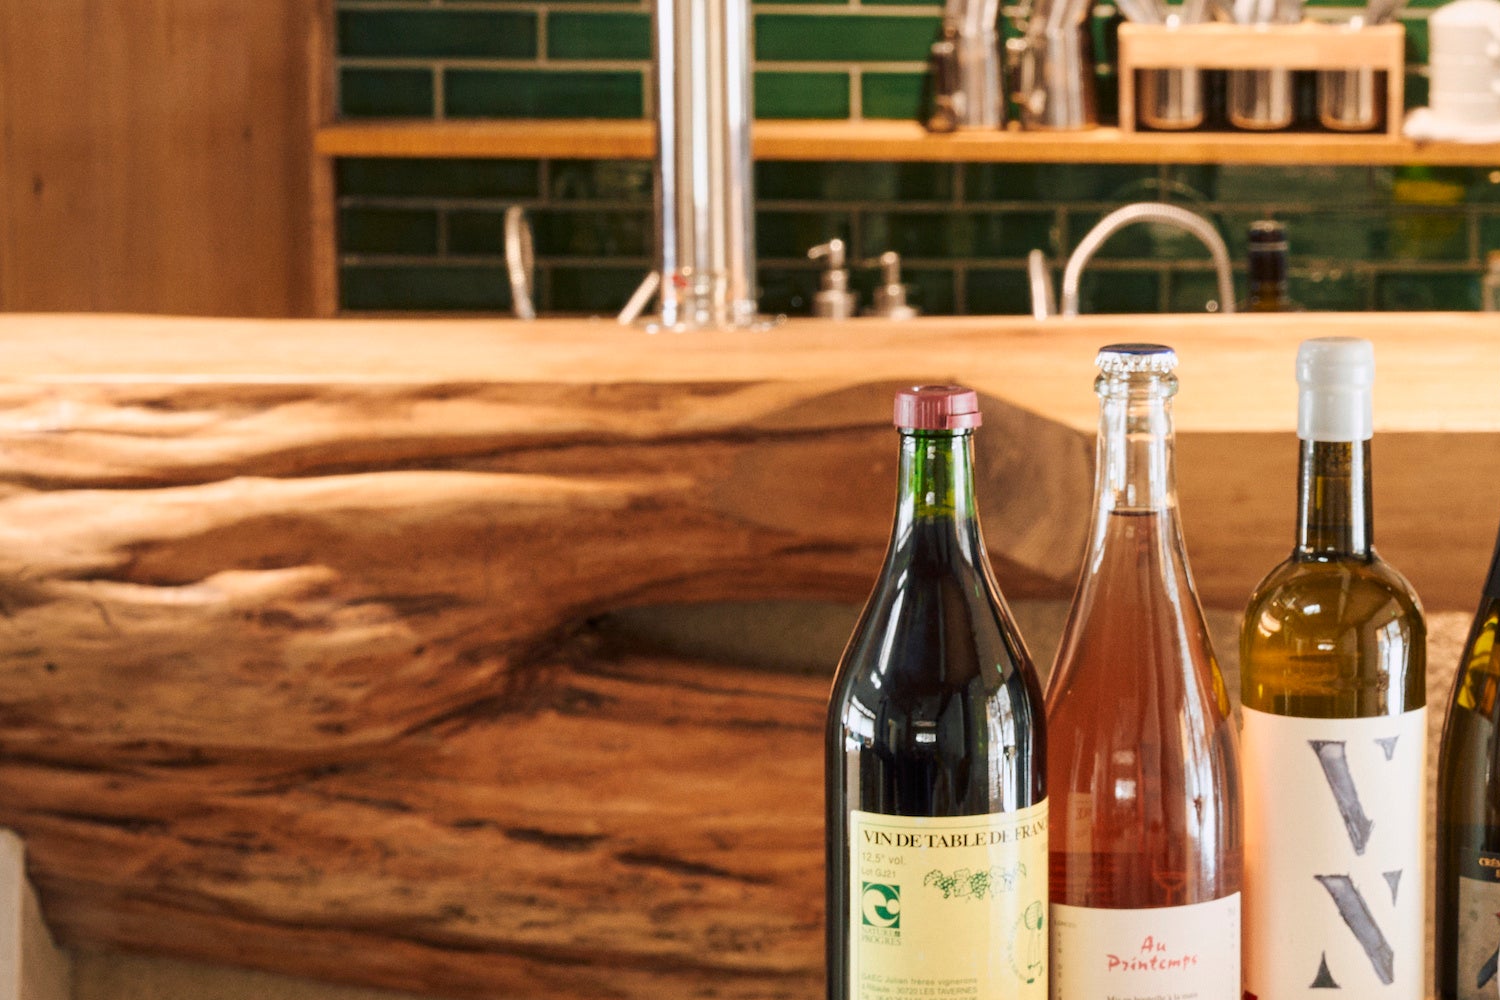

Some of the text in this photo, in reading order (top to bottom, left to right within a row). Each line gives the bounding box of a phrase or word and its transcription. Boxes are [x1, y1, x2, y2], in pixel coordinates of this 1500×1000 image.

[863, 829, 893, 846] VIN
[895, 833, 922, 848] DE
[924, 832, 987, 848] TABLE
[989, 829, 1010, 845] DE
[1140, 934, 1167, 953] Au
[1106, 953, 1199, 973] Printemps
